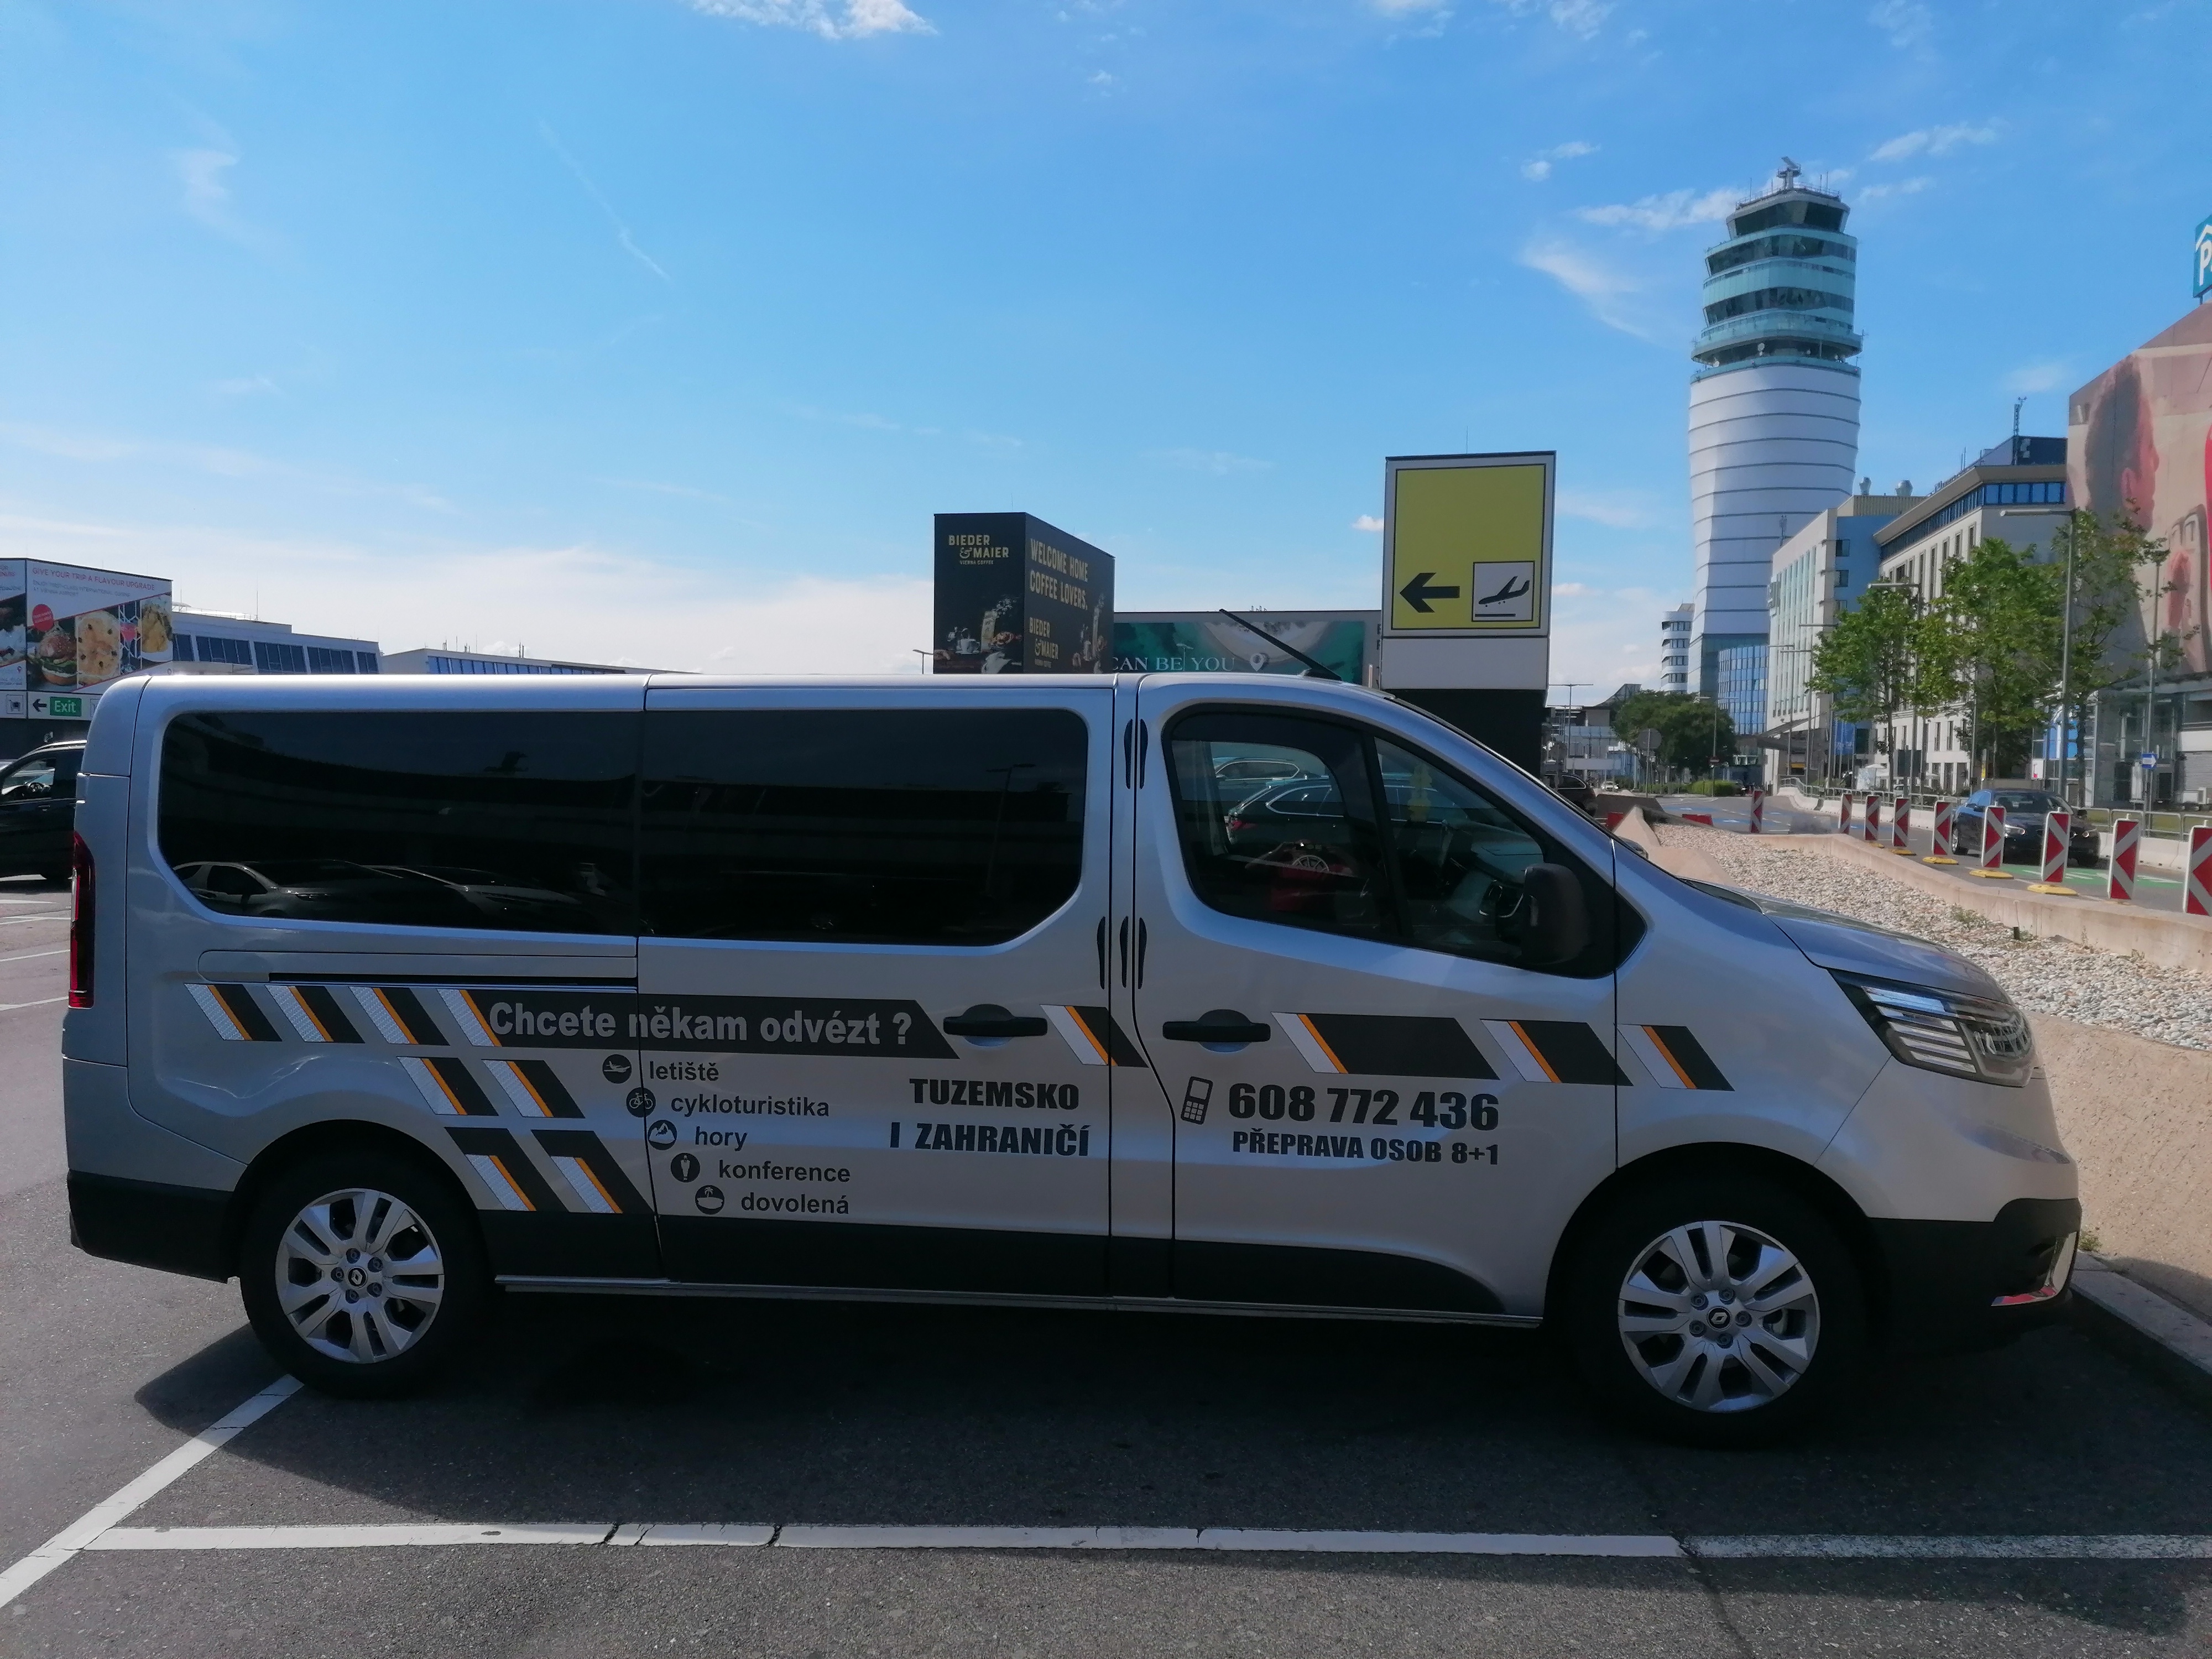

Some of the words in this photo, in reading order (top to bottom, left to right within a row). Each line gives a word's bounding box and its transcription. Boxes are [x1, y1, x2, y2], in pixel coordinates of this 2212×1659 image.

[2199, 239, 2212, 286] P
[948, 535, 990, 546] BIEDER
[1030, 538, 1067, 575] WELCOME
[1070, 556, 1088, 582] HOME
[32, 567, 49, 576] GIVE
[50, 570, 70, 578] YOUR
[72, 572, 87, 581] TRIP
[95, 576, 124, 586] FLAVOUR
[126, 581, 155, 591] UPGRADE
[1030, 570, 1057, 600] COFFEE
[1060, 582, 1088, 611] LOVERS.
[1029, 617, 1051, 638] BIEDER
[1156, 657, 1183, 671] BE
[1191, 657, 1235, 671] YOU
[54, 700, 76, 713] Exit
[489, 1002, 616, 1037] Chcete
[628, 1005, 747, 1041] někam
[760, 1010, 880, 1045] odvézt
[893, 1012, 912, 1045] ?
[649, 1060, 719, 1082] letiště
[670, 1094, 830, 1118] cykloturistika
[909, 1078, 1079, 1110] TUZEMSKO
[1228, 1082, 1316, 1121] 608
[1327, 1088, 1400, 1126] 772
[1410, 1091, 1499, 1131] 436
[695, 1126, 748, 1152] hory
[890, 1121, 900, 1148] I
[914, 1123, 1092, 1157] ZAHRANIČÍ
[1233, 1128, 1365, 1159] PŘEPRAVA
[1370, 1137, 1442, 1163] OSOB
[1451, 1142, 1499, 1165] 8+1
[718, 1160, 851, 1183] konference
[741, 1192, 850, 1215] dovolená
